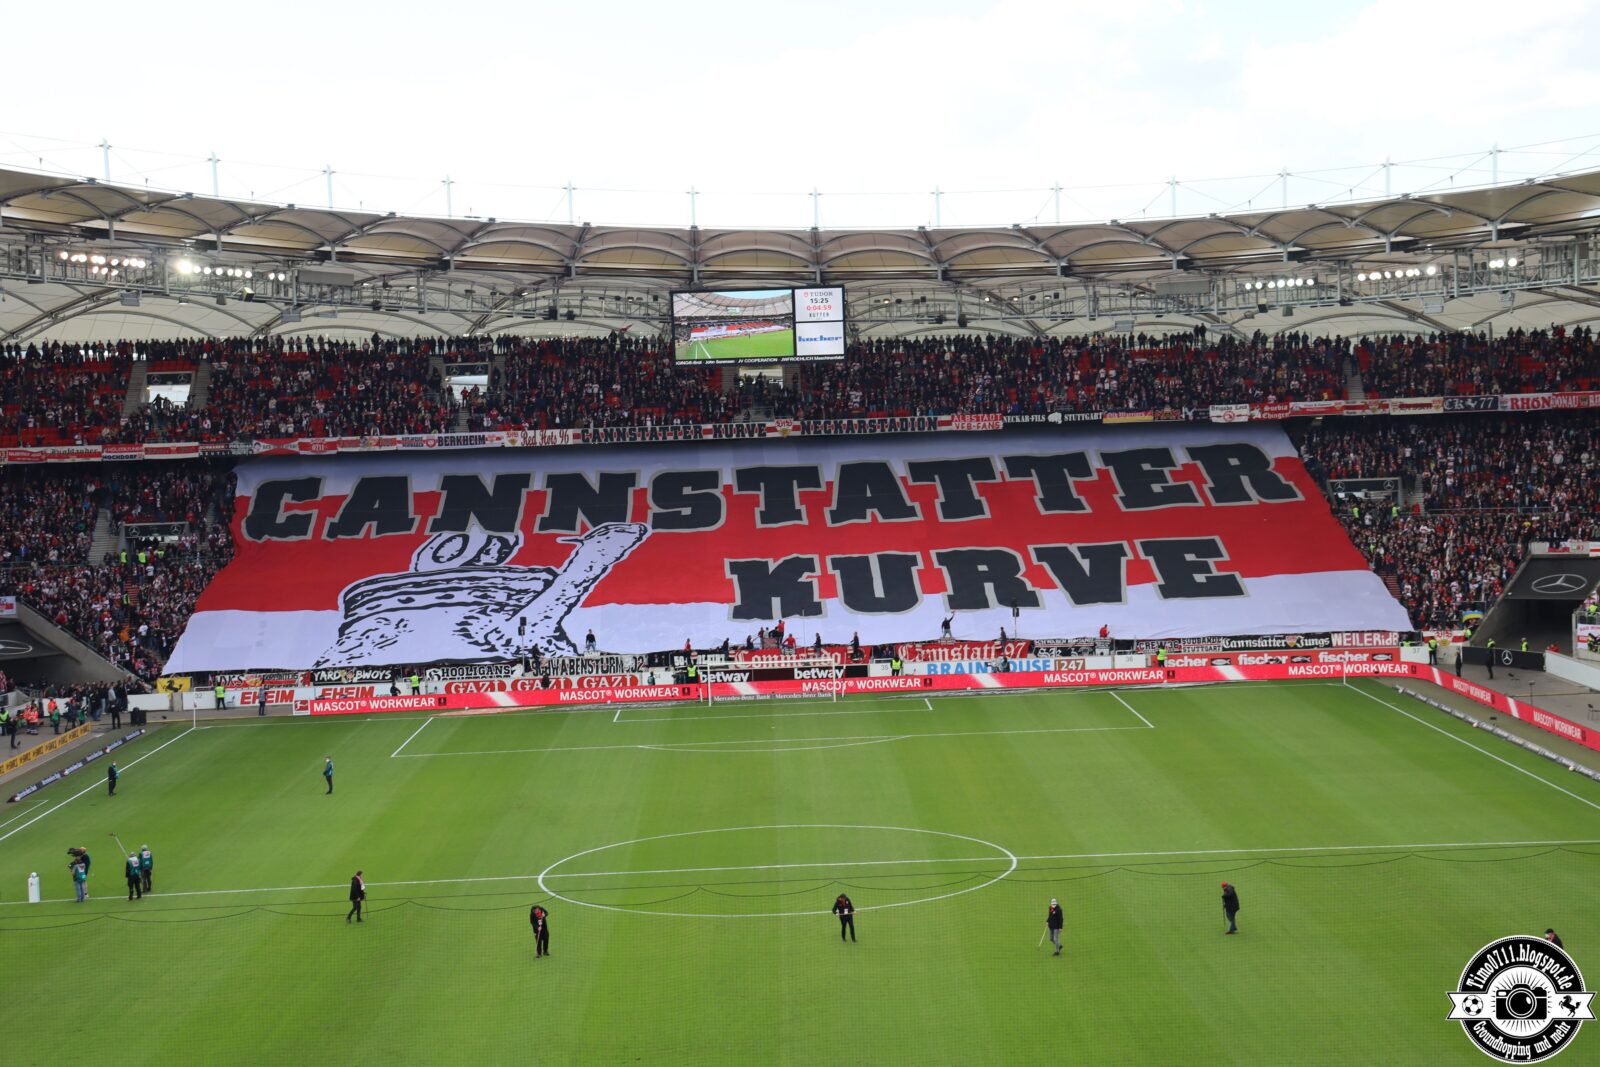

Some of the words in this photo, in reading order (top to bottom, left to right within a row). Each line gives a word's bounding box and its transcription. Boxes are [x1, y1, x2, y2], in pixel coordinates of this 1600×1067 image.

[1480, 397, 1493, 410] 77
[1510, 396, 1551, 410] RHÖN
[1552, 396, 1579, 408] DONAU
[952, 413, 1002, 422] ALBSTADT
[1003, 414, 1046, 423] NECKAR-FILS
[1064, 412, 1103, 422] STUTTGART
[801, 416, 938, 434] NECKARSTADION
[522, 430, 538, 447] Red
[539, 430, 558, 446] Hots
[580, 424, 703, 443] CANNSTATTER
[712, 423, 766, 438] KURVE
[438, 434, 486, 446] BERKHEIM
[242, 443, 1305, 541] CANNSTATTER
[724, 536, 1250, 622] KURVE
[1222, 636, 1286, 649] Cannstatter
[1296, 636, 1330, 648] Jungs
[1004, 641, 1026, 659] 97
[1163, 656, 1208, 668] ischer
[1318, 652, 1370, 662] fischer
[442, 665, 511, 676] HOOLIGANS
[1061, 660, 1084, 671] 247
[1343, 663, 1408, 674] WORKWEAR
[314, 670, 341, 681] YARD
[356, 670, 392, 680] BWOYS
[700, 671, 750, 684] betway
[794, 667, 844, 680] betway
[1098, 670, 1164, 681] WORKWEAR
[856, 678, 920, 690] WORKWEAR
[240, 690, 294, 704] EHEIM
[615, 687, 680, 698] WORKWEAR
[370, 697, 435, 709] WORKWEAR
